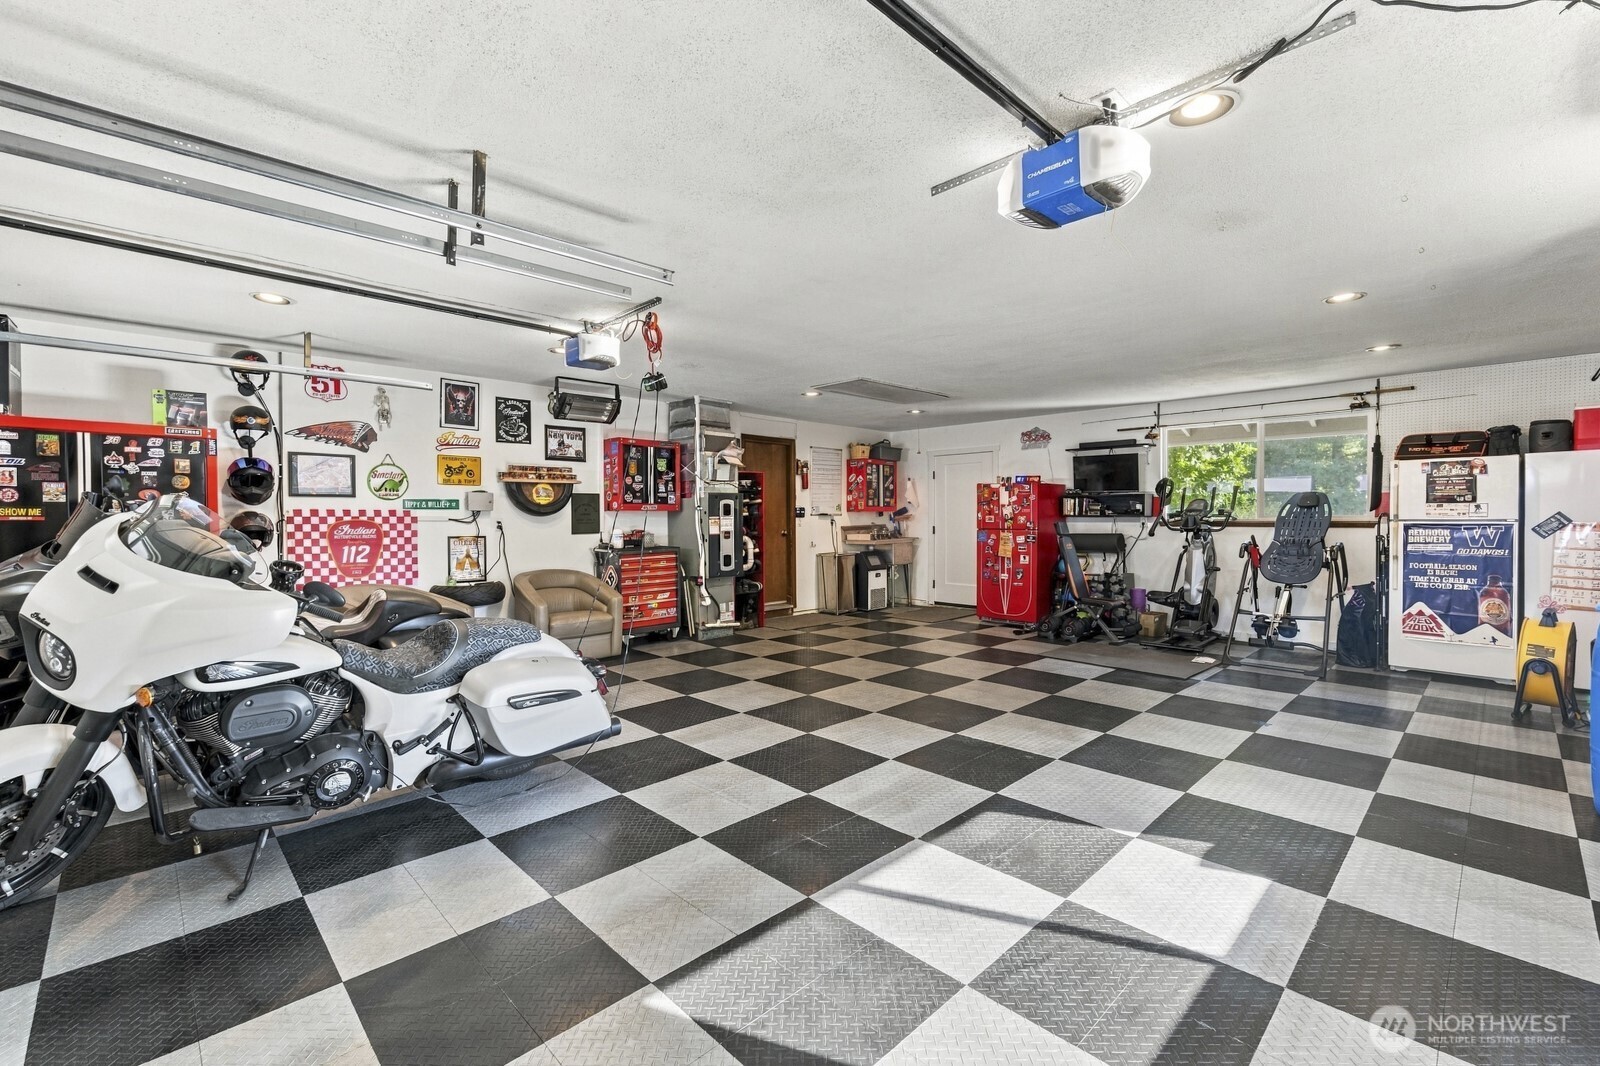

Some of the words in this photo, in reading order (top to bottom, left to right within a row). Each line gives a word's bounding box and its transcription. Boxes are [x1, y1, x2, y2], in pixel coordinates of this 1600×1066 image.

[1027, 157, 1074, 179] CHAMBERLAIN
[311, 376, 341, 395] 51
[437, 432, 481, 448] Indian
[371, 470, 404, 479] Sinclair
[334, 524, 377, 535] Indian
[1462, 526, 1504, 547] W
[342, 545, 370, 563] 112
[1403, 624, 1438, 632] HOOK
